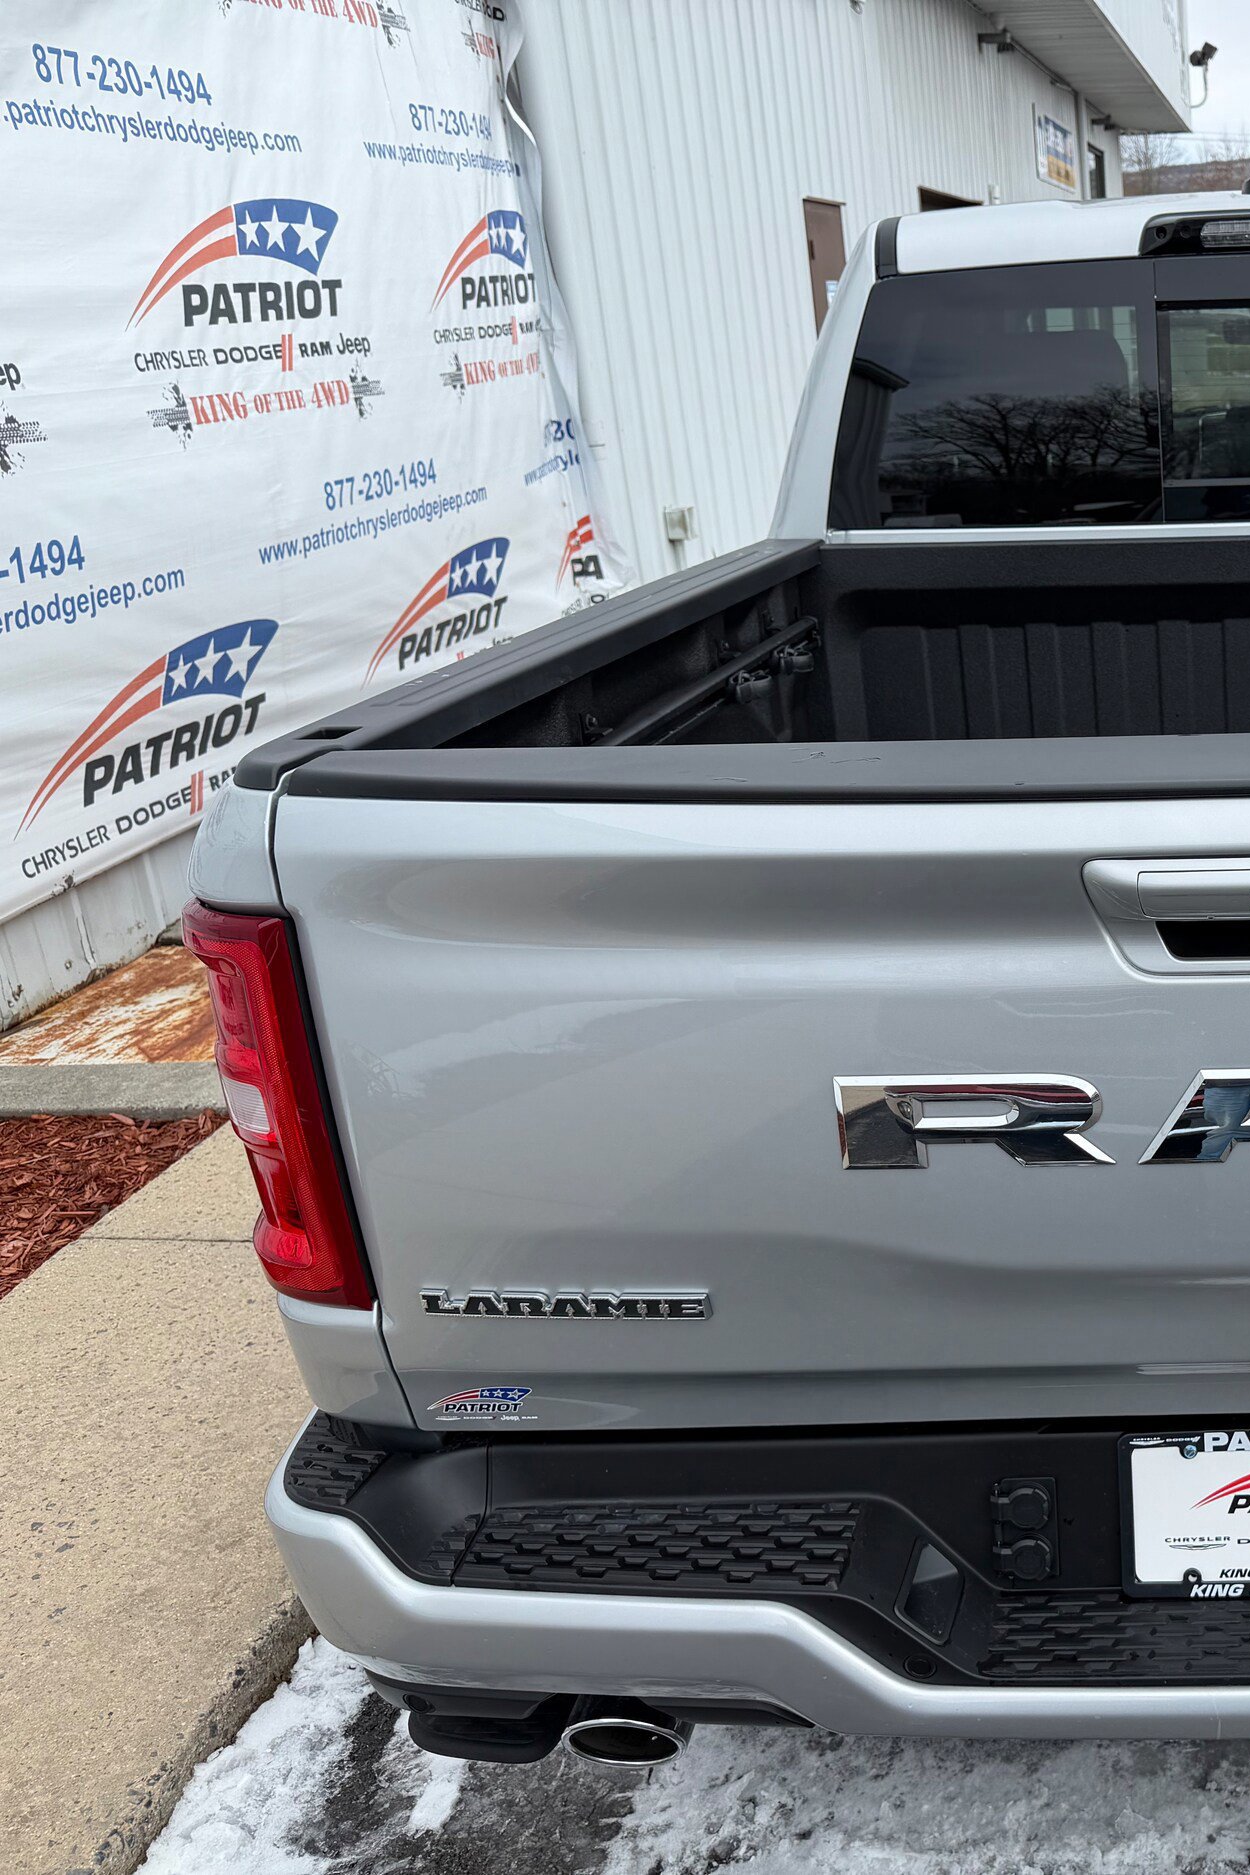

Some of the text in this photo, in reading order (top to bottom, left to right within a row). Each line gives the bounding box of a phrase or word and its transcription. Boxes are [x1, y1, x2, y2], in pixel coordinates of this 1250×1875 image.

[32, 43, 212, 106] 877-230-1494
[3, 98, 302, 155] .patriotchryslerdodgejeep.com
[181, 279, 343, 328] PATRIOT
[461, 273, 537, 310] PATRIOT
[134, 333, 371, 373] CHRYSLER DODGE RAM Jeep
[434, 326, 475, 345] CHRYSLER
[464, 359, 496, 386] KING
[190, 379, 351, 426] KING OF THE 4WD
[323, 457, 437, 512] 877-230-1494
[258, 486, 488, 565] www.patriotchryslerdodgejeep.com
[398, 596, 509, 672] PATRIOT
[83, 692, 267, 808] PATRIOT
[21, 765, 237, 880] CHRYSLER DODGE RA
[419, 1287, 714, 1321] LARAMIE
[443, 1401, 524, 1414] PATRIOT
[1164, 1536, 1231, 1544] CHRYSLER
[1190, 1584, 1245, 1599] KING
